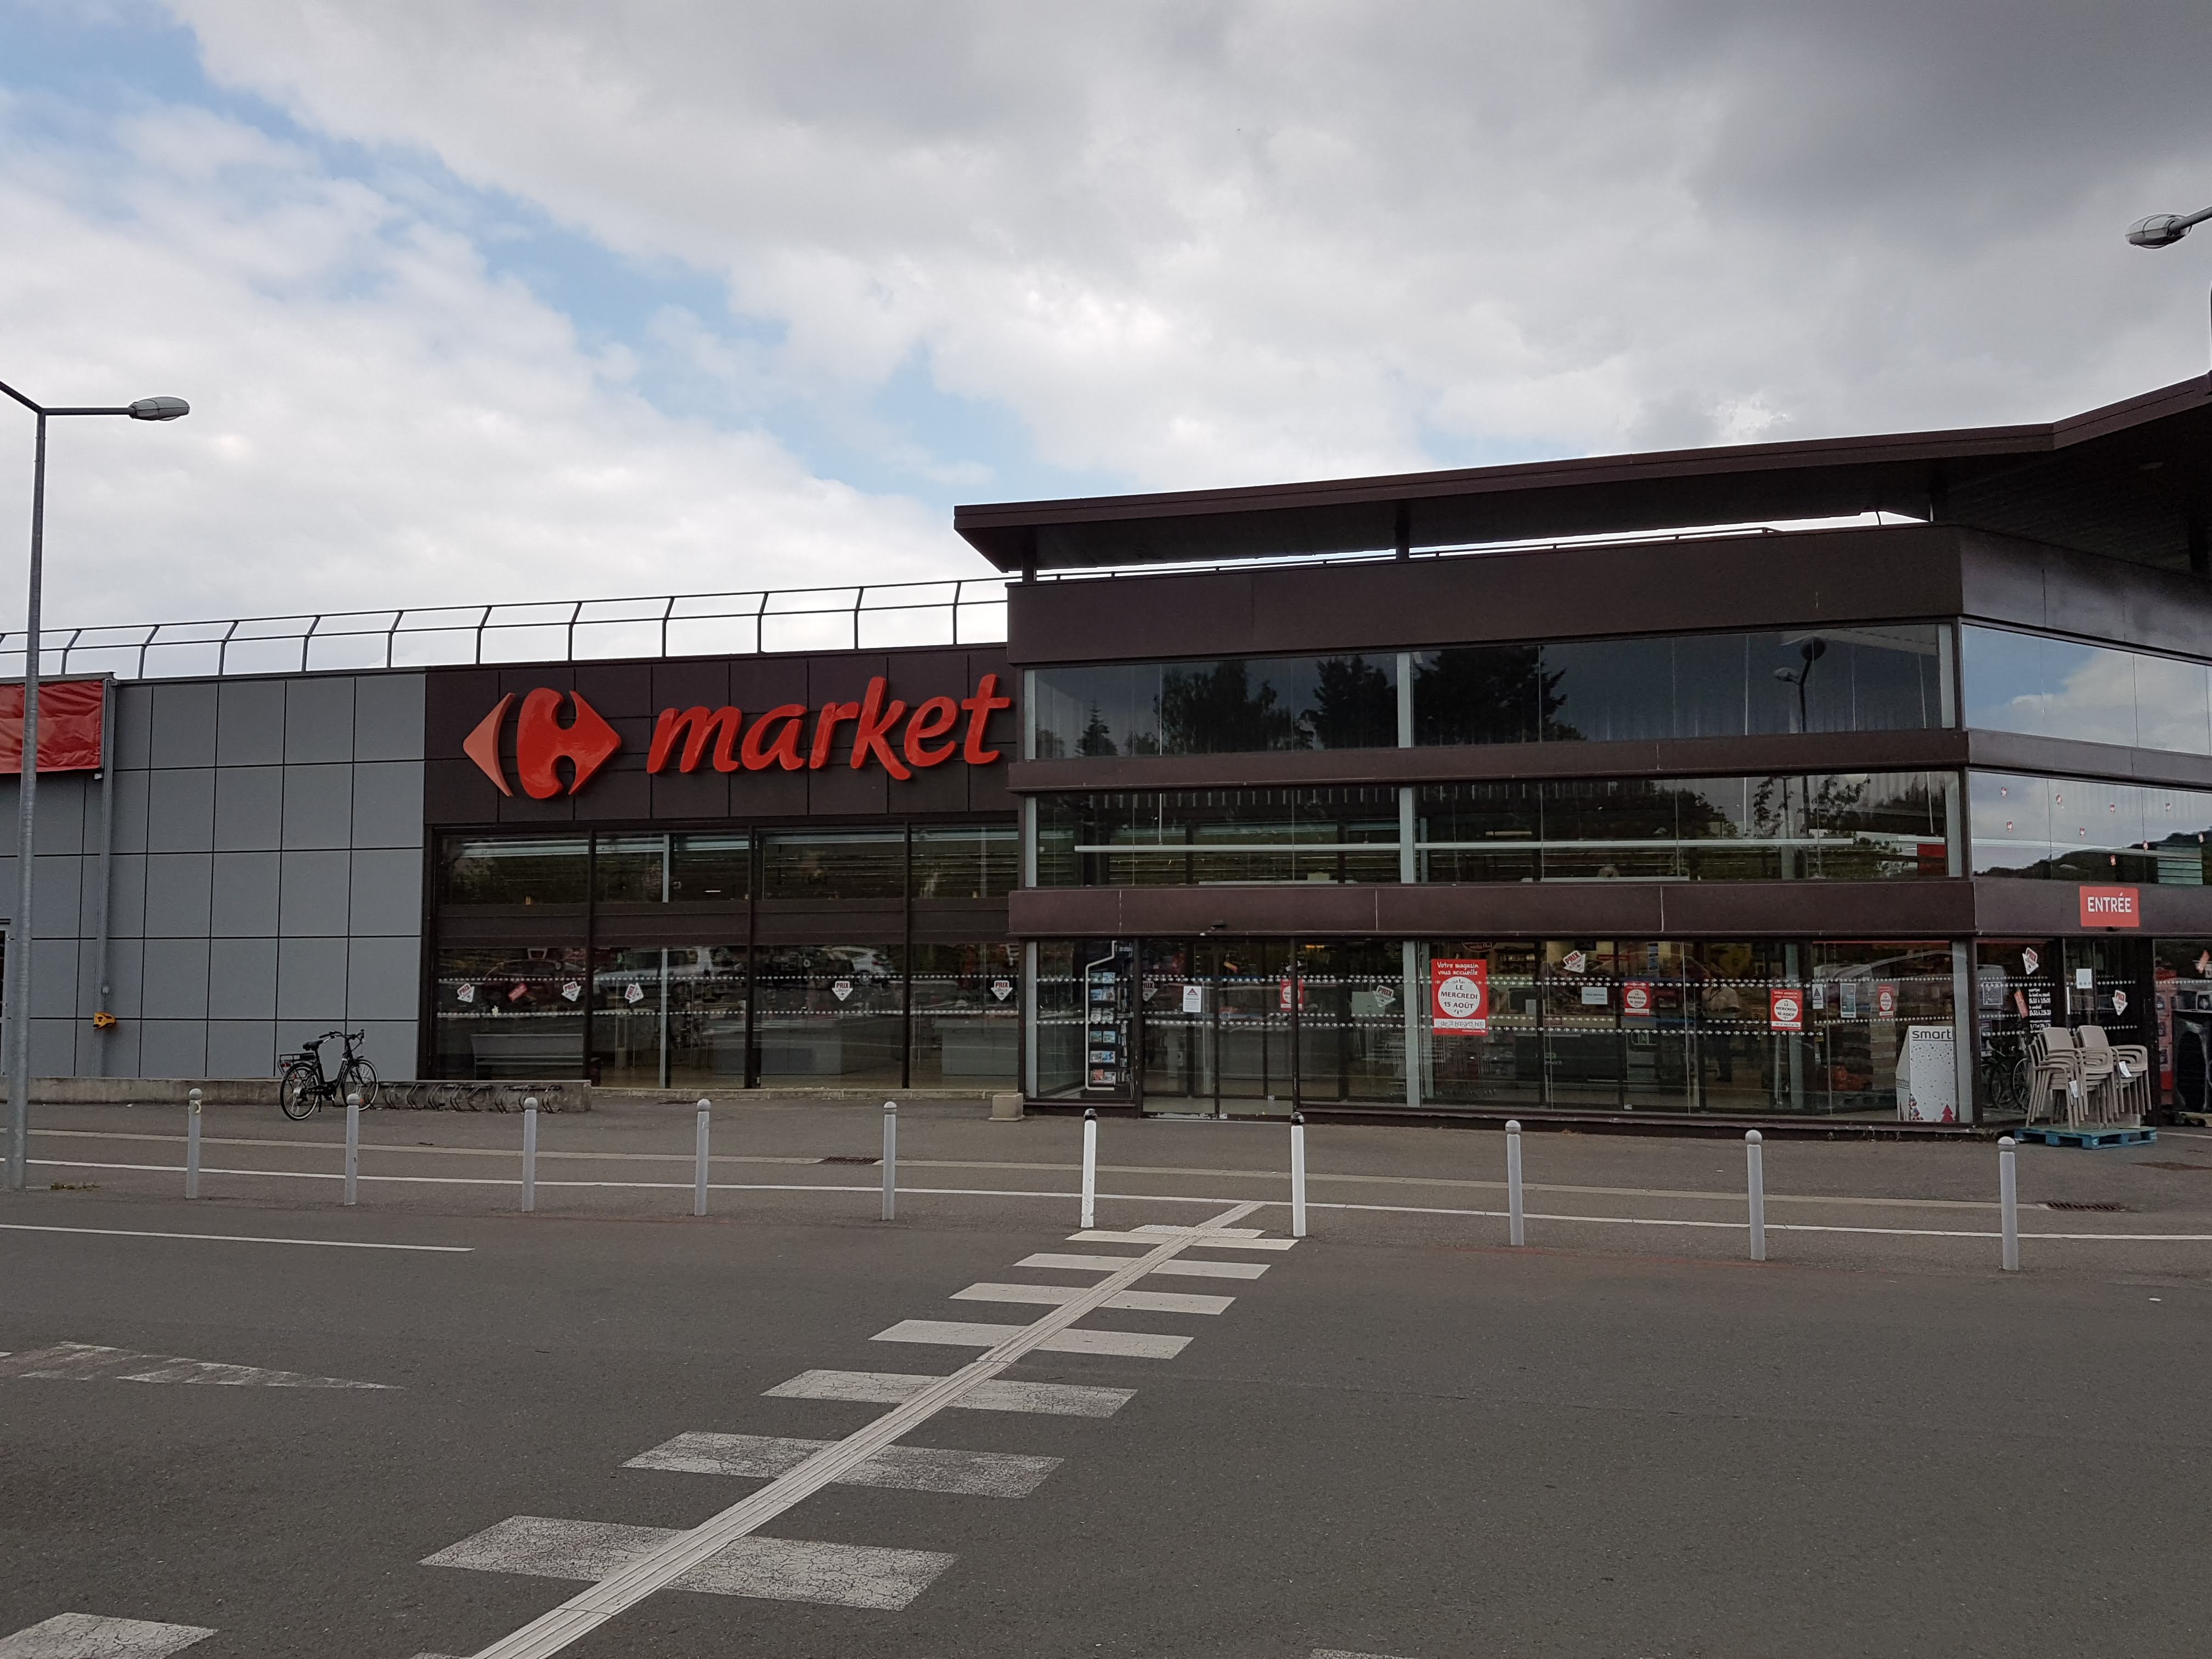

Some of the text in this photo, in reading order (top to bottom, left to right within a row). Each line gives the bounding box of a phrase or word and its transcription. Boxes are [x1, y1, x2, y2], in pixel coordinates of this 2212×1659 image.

[646, 674, 1012, 780] market
[2087, 891, 2132, 913] ENTRÉE
[1565, 952, 1580, 964] PRIX
[565, 983, 577, 991] PRIX
[627, 984, 635, 998] PRIX
[1378, 987, 1393, 996] PRIX
[1440, 991, 1478, 1000] MERCREDI
[1912, 1029, 1952, 1039] smart
